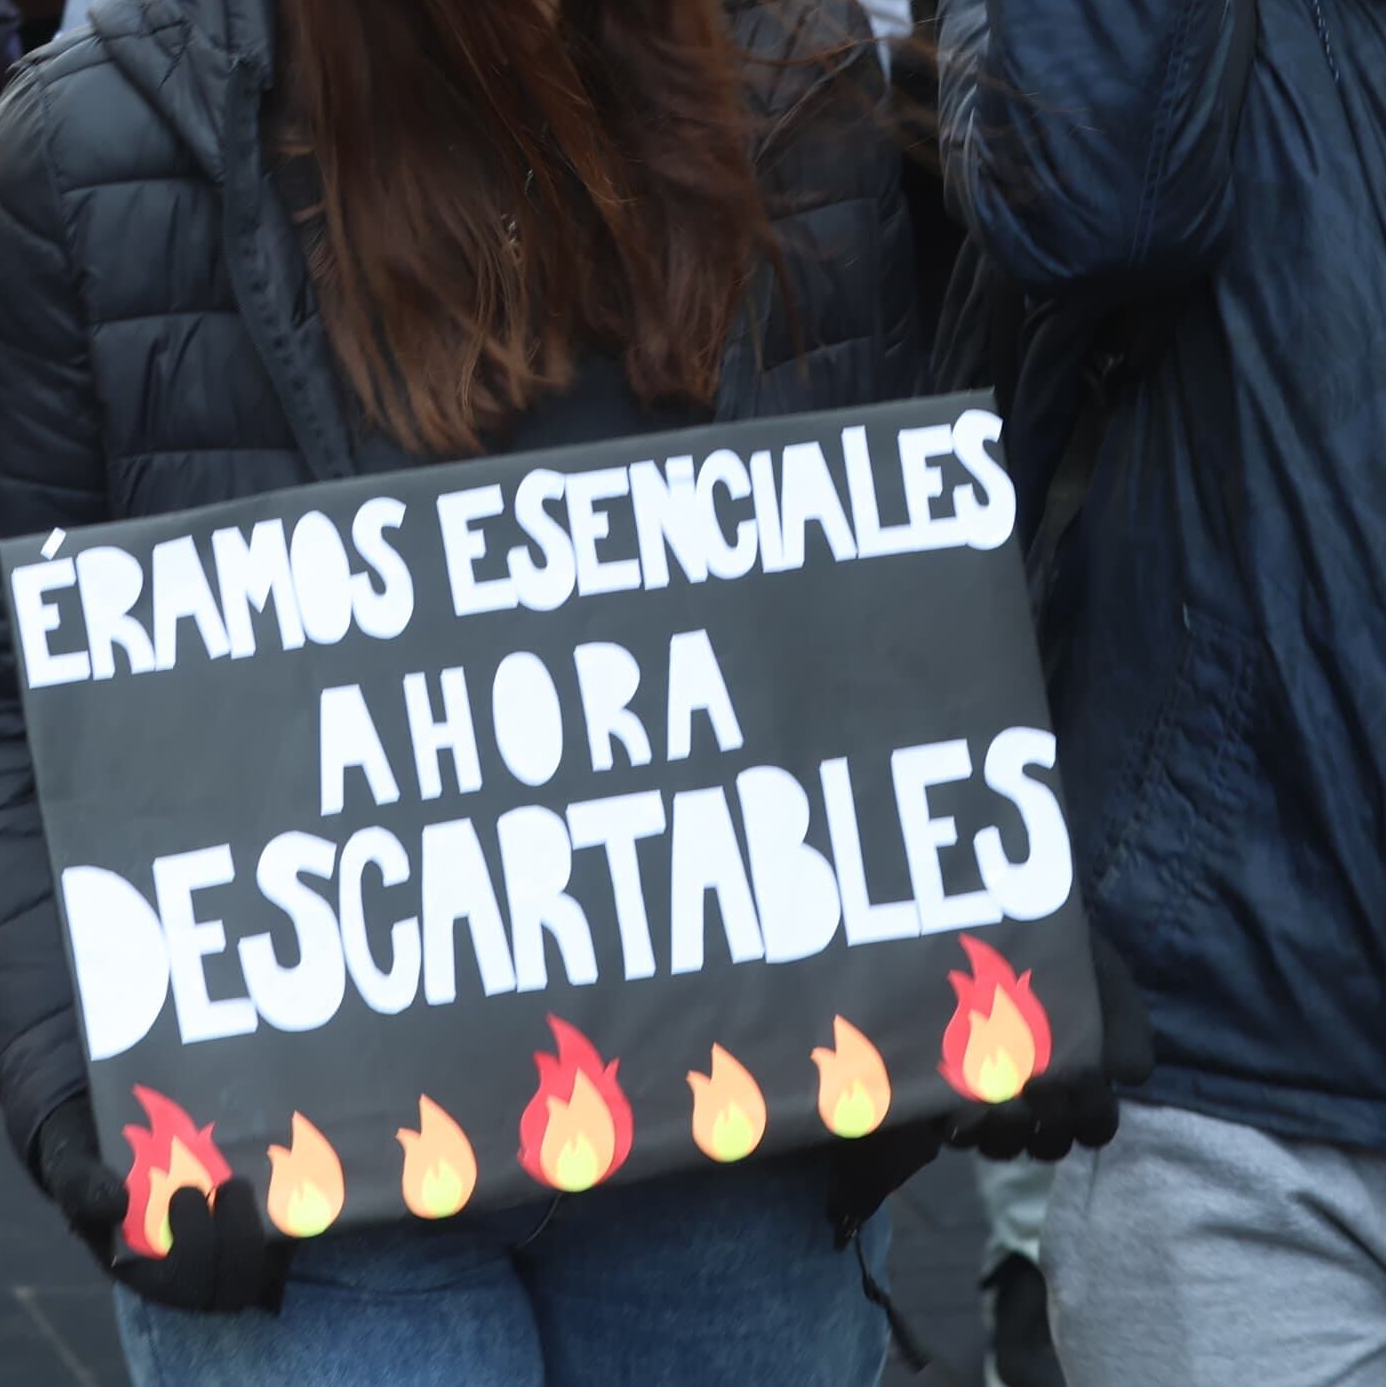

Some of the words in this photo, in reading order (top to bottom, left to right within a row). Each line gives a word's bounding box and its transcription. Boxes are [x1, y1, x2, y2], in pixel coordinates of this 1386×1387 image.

[12, 497, 415, 689] ÉRAMOS
[437, 409, 1016, 617] ESENCIALES
[320, 628, 744, 817] AHORA
[61, 726, 1074, 1062] DESCARTABLES
